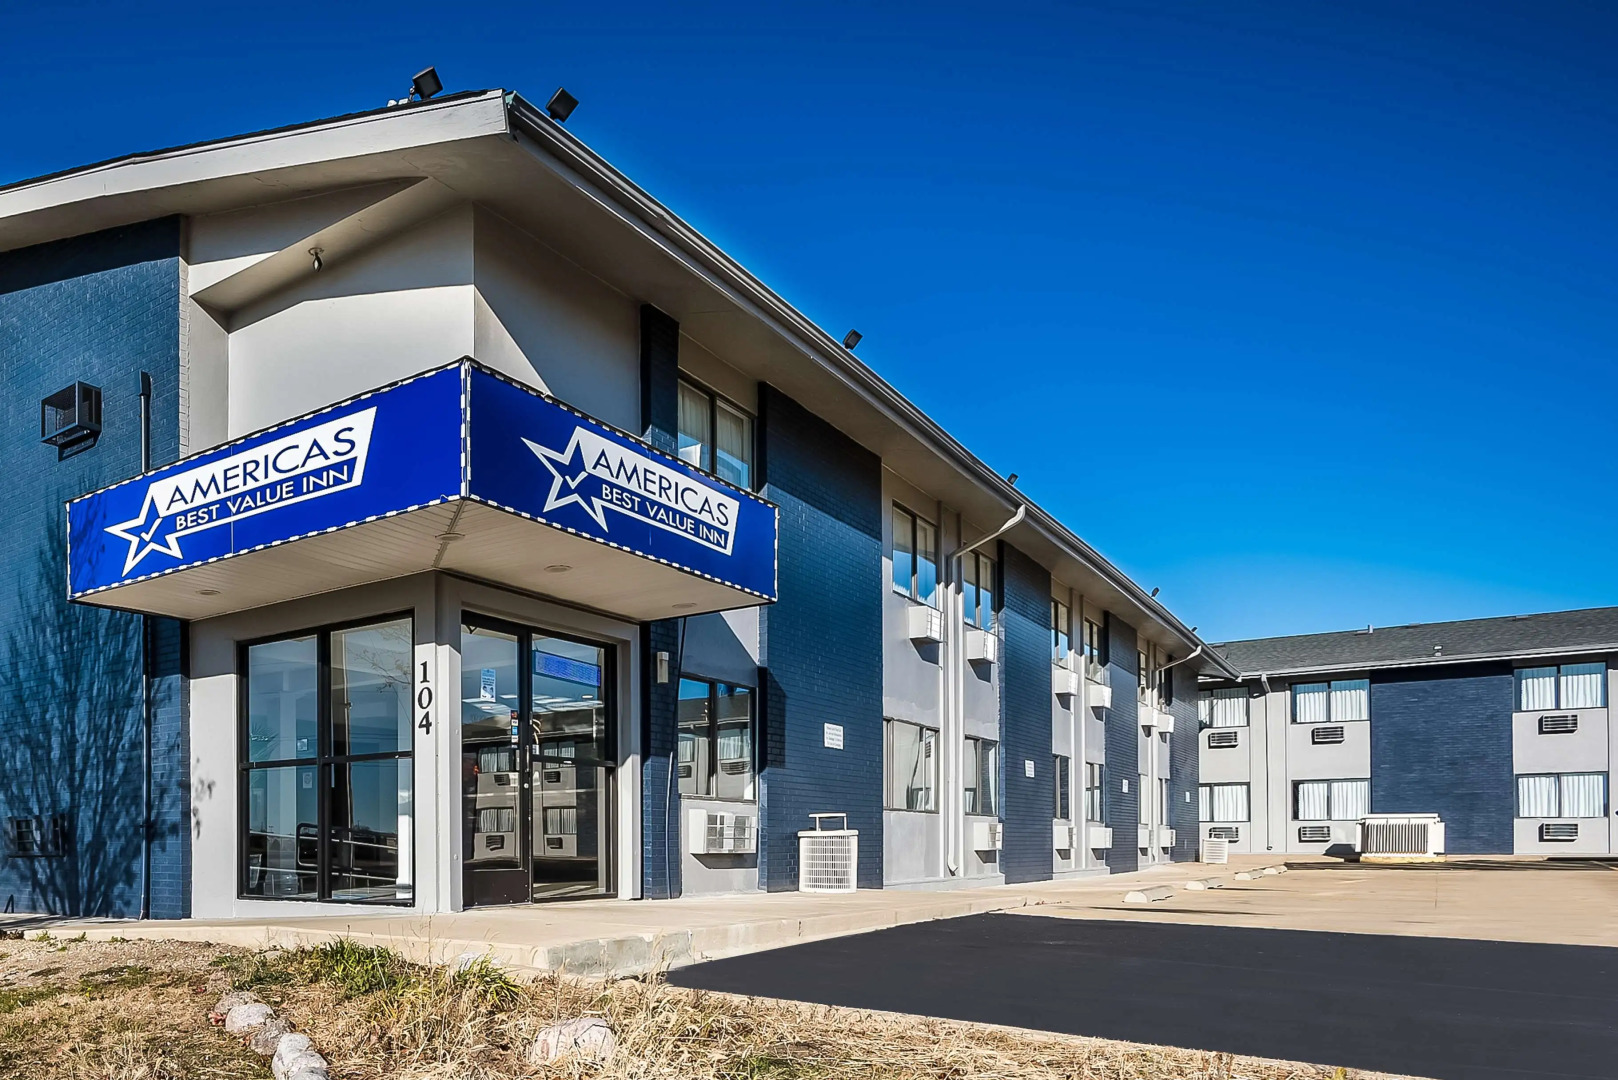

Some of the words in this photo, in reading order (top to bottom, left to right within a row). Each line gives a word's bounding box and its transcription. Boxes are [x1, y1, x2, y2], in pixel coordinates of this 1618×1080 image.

[166, 427, 356, 511] AMERICAS
[176, 504, 220, 531] BEST
[227, 481, 294, 514] VALUE
[302, 465, 348, 493] INN
[592, 448, 729, 527] AMERICAS
[602, 484, 641, 512] BEST
[646, 501, 695, 534] VALUE
[699, 524, 725, 547] INN
[417, 660, 433, 736] 104
